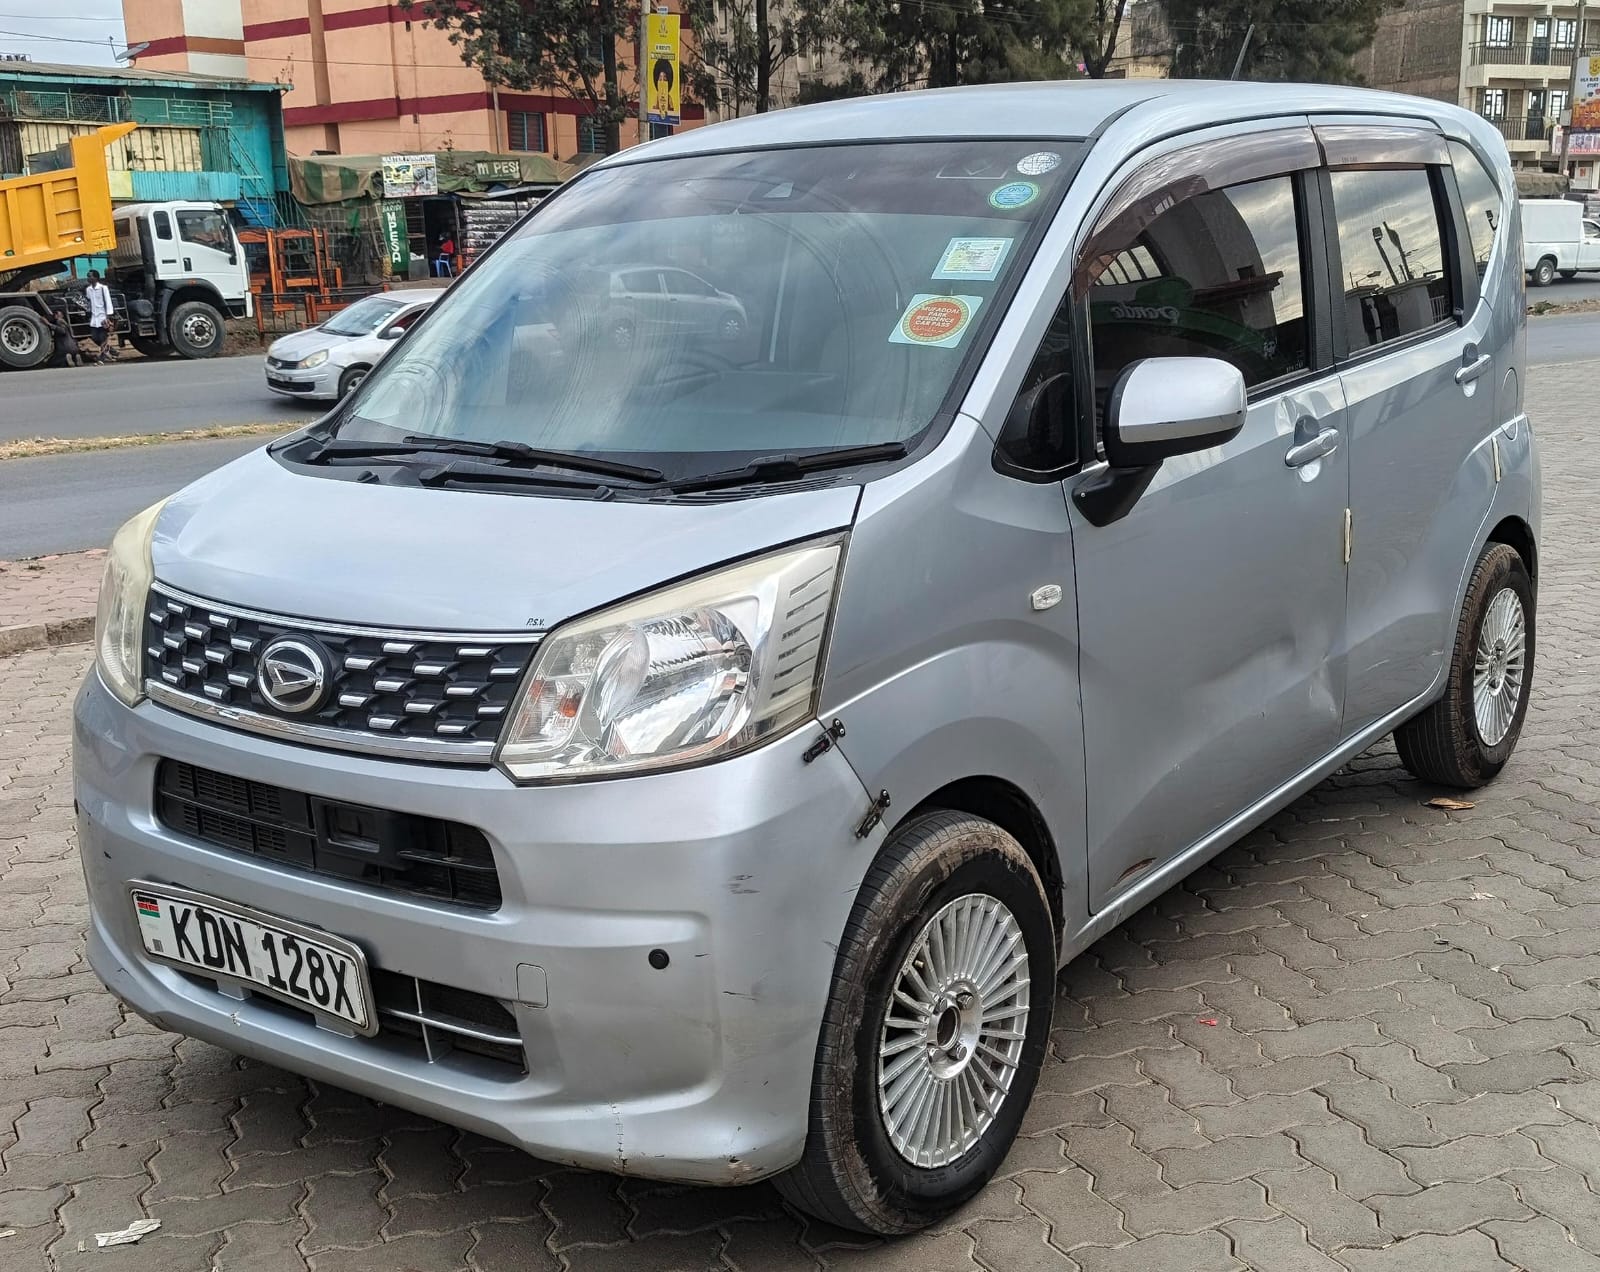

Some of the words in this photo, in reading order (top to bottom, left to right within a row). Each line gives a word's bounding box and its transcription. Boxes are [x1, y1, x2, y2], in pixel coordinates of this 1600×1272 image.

[386, 212, 402, 263] MPESA
[169, 905, 252, 977] KDN
[261, 931, 356, 1020] 128X
